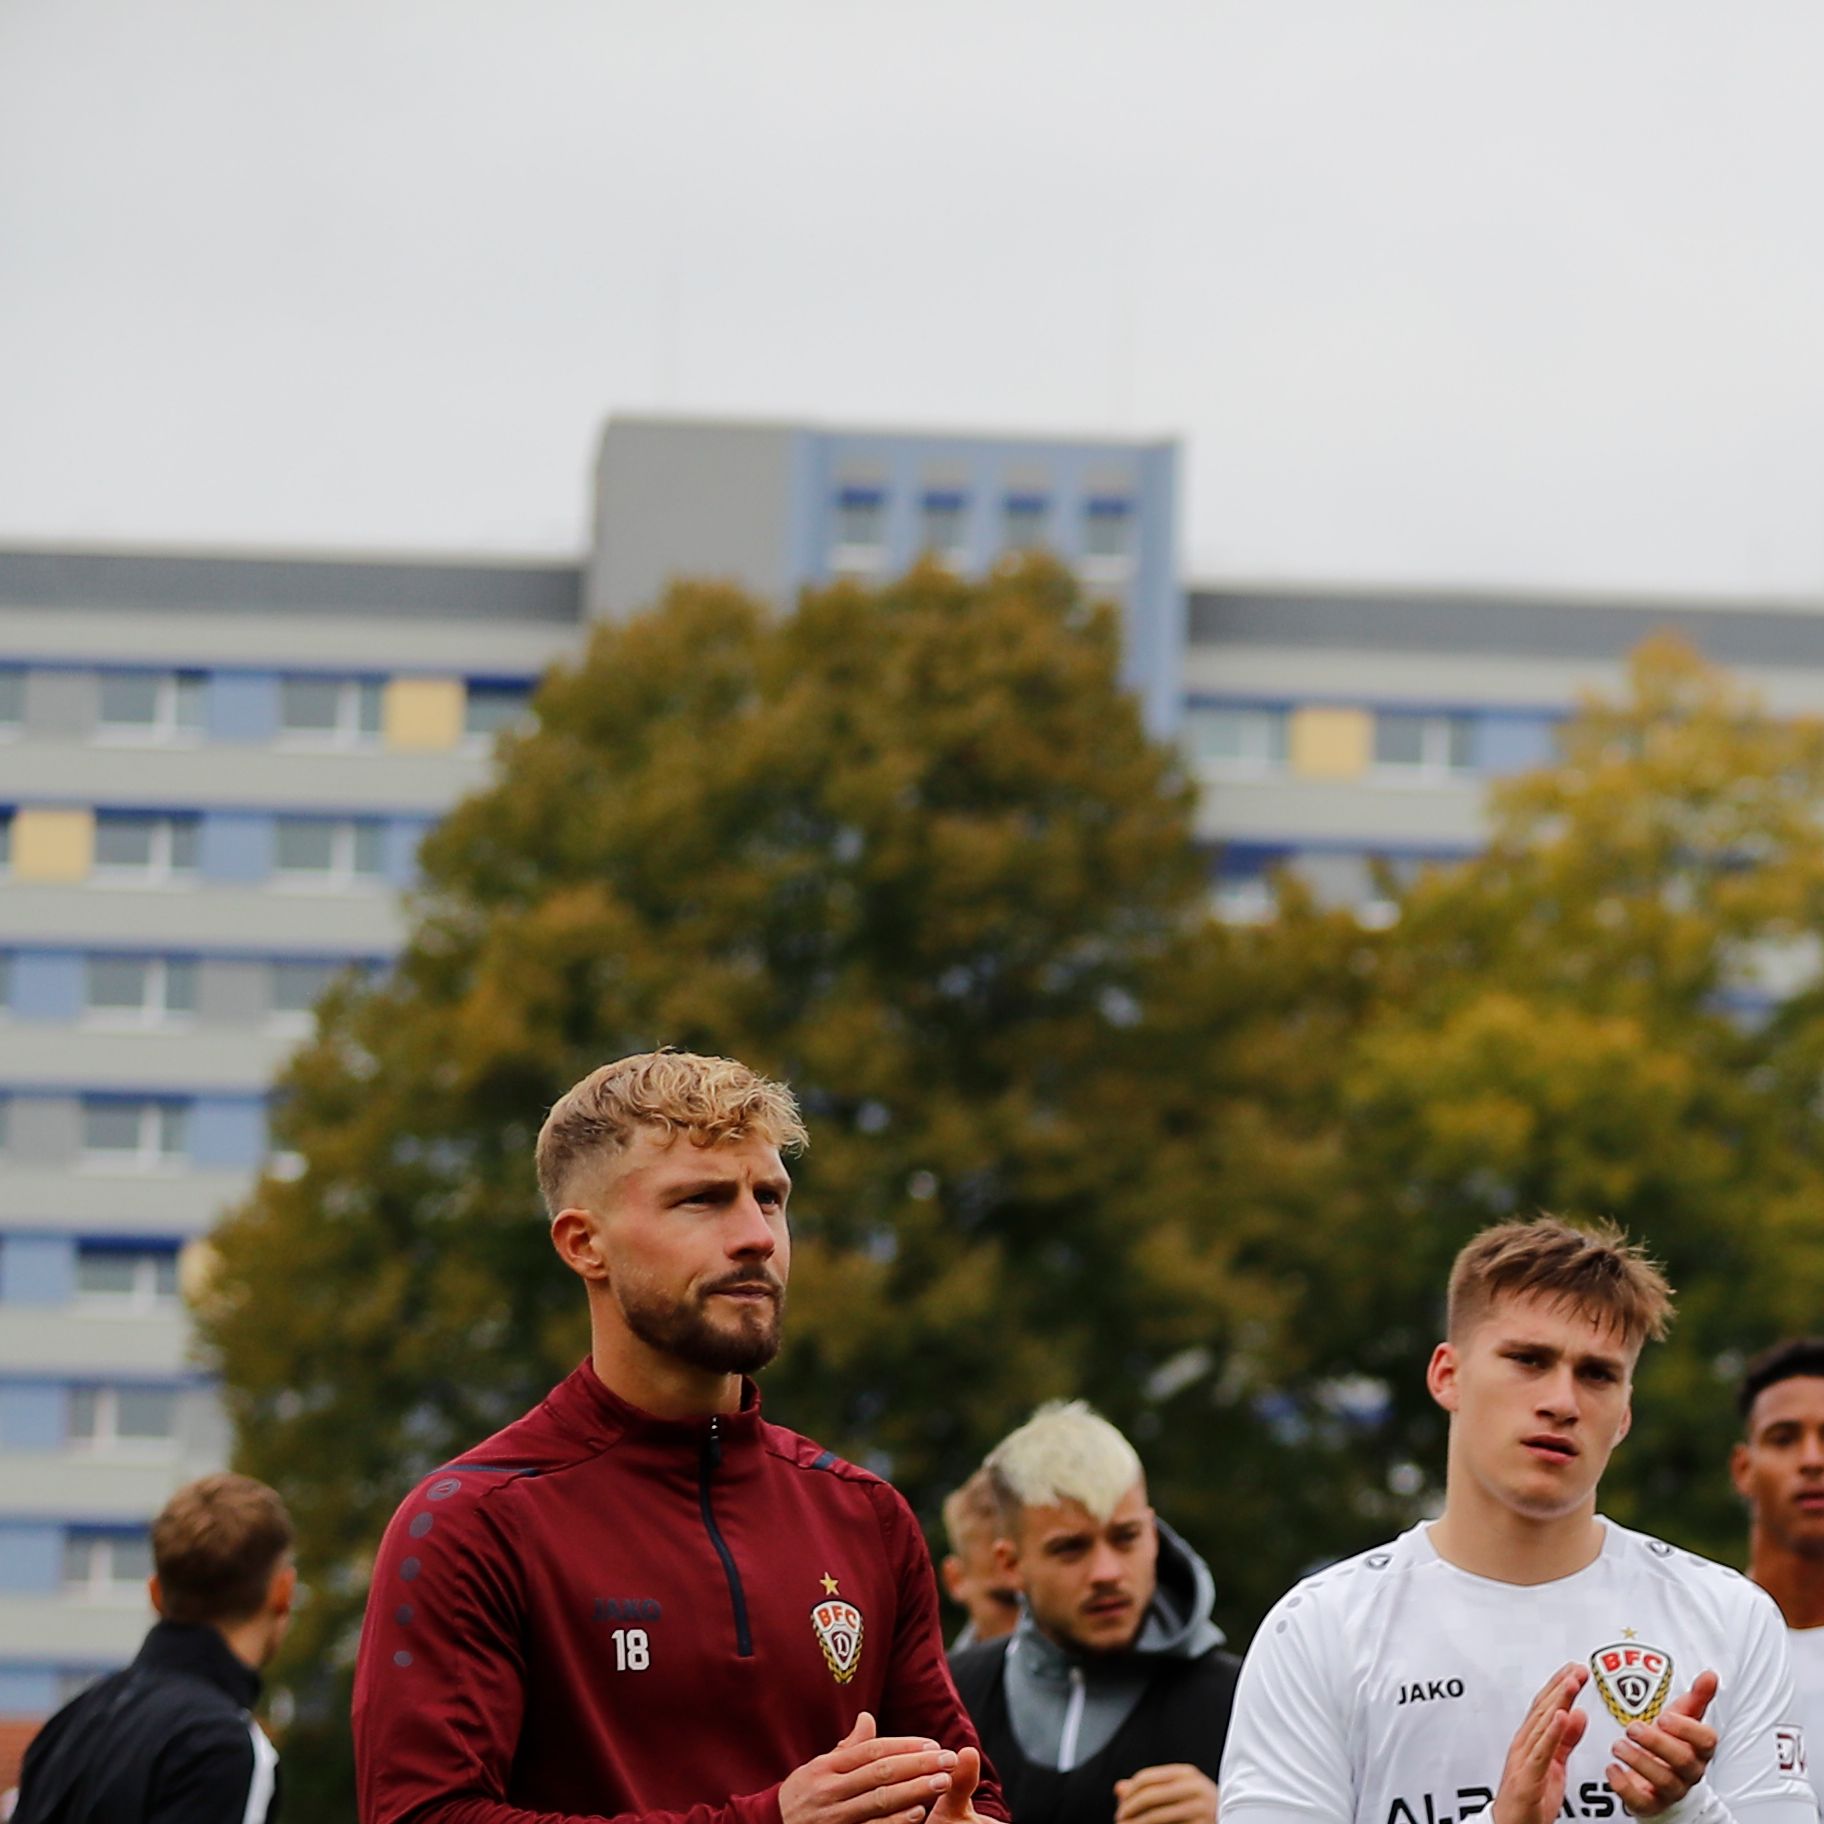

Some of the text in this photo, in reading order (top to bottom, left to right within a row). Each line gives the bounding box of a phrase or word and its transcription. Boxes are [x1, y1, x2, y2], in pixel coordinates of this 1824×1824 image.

[815, 1604, 858, 1629] BFC
[611, 1629, 650, 1671] 18
[1600, 1650, 1663, 1674] BFC
[1397, 1678, 1465, 1706] JAKO
